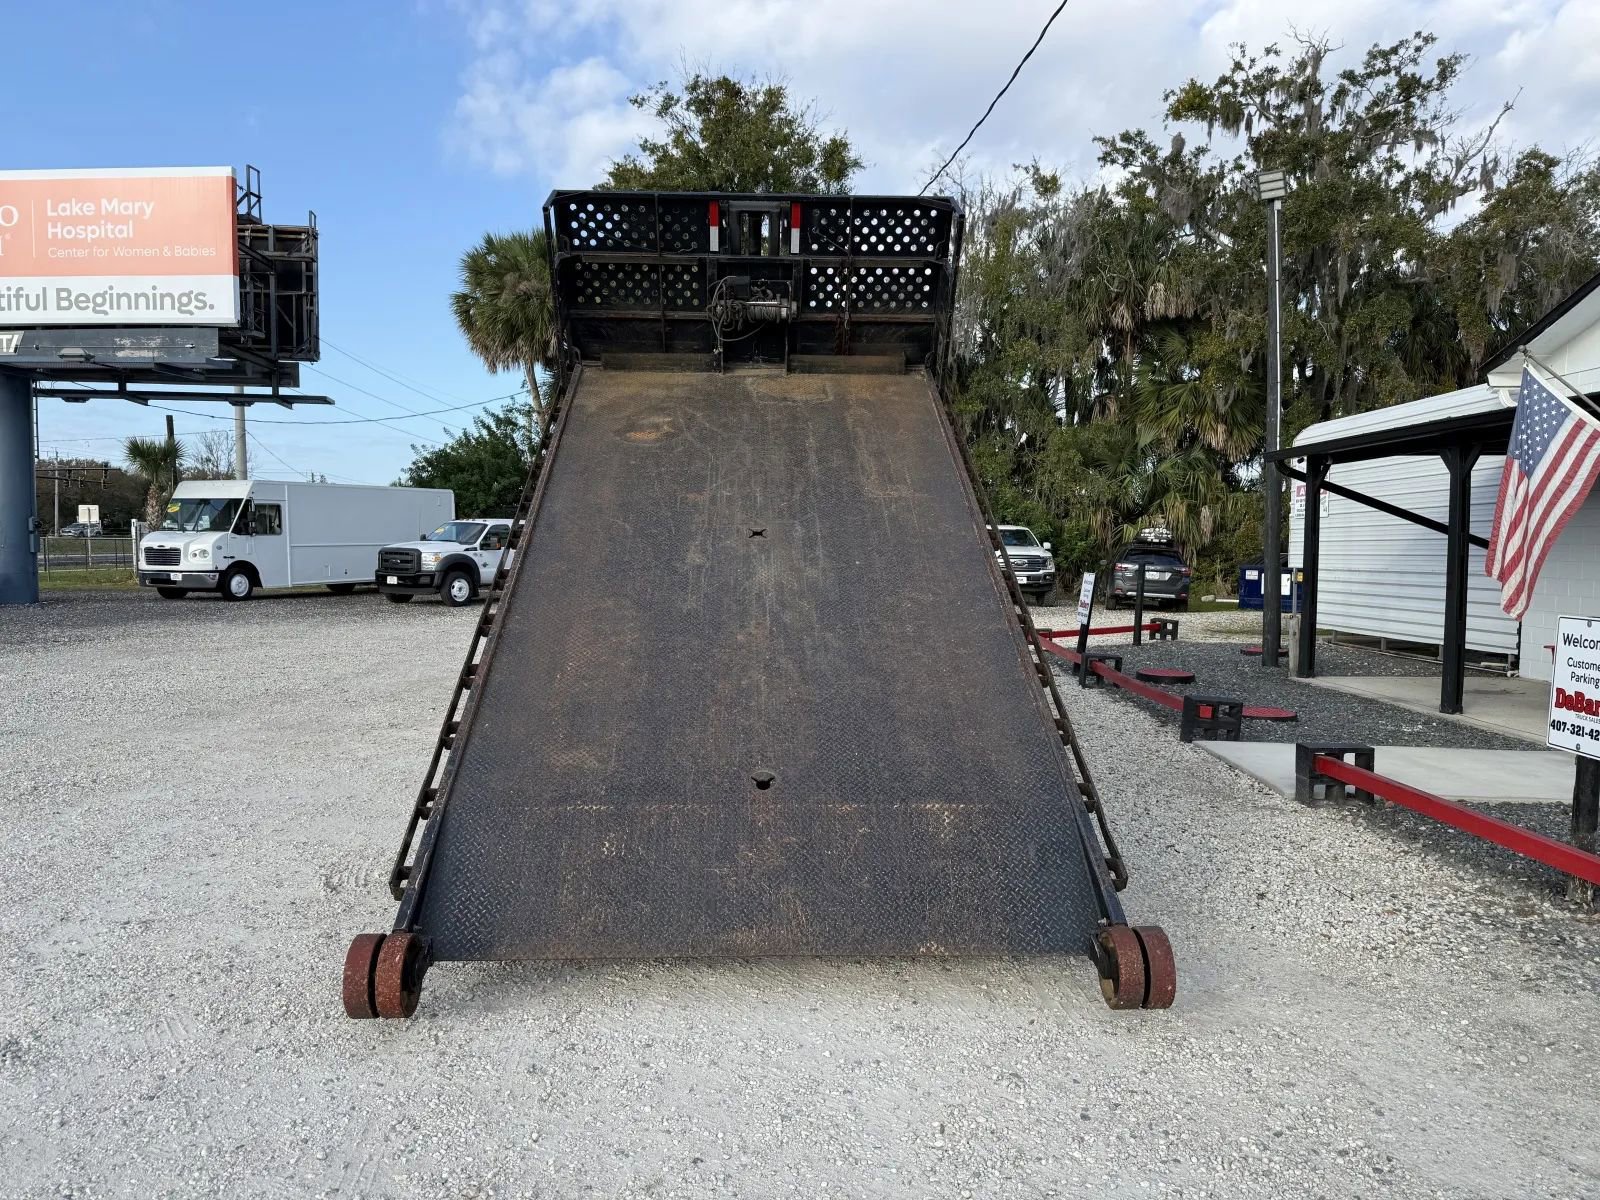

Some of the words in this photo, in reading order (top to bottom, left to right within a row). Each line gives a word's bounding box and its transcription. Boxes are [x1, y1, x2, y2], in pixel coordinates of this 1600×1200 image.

[46, 197, 96, 217] Lake
[100, 197, 155, 220] Mary
[47, 219, 134, 243] Hospital
[47, 247, 90, 258] Center
[92, 245, 109, 257] for
[113, 246, 160, 257] Women
[162, 246, 172, 257] &
[174, 244, 217, 257] Babies
[55, 284, 215, 316] Beginnings.
[1570, 671, 1600, 690] Parking
